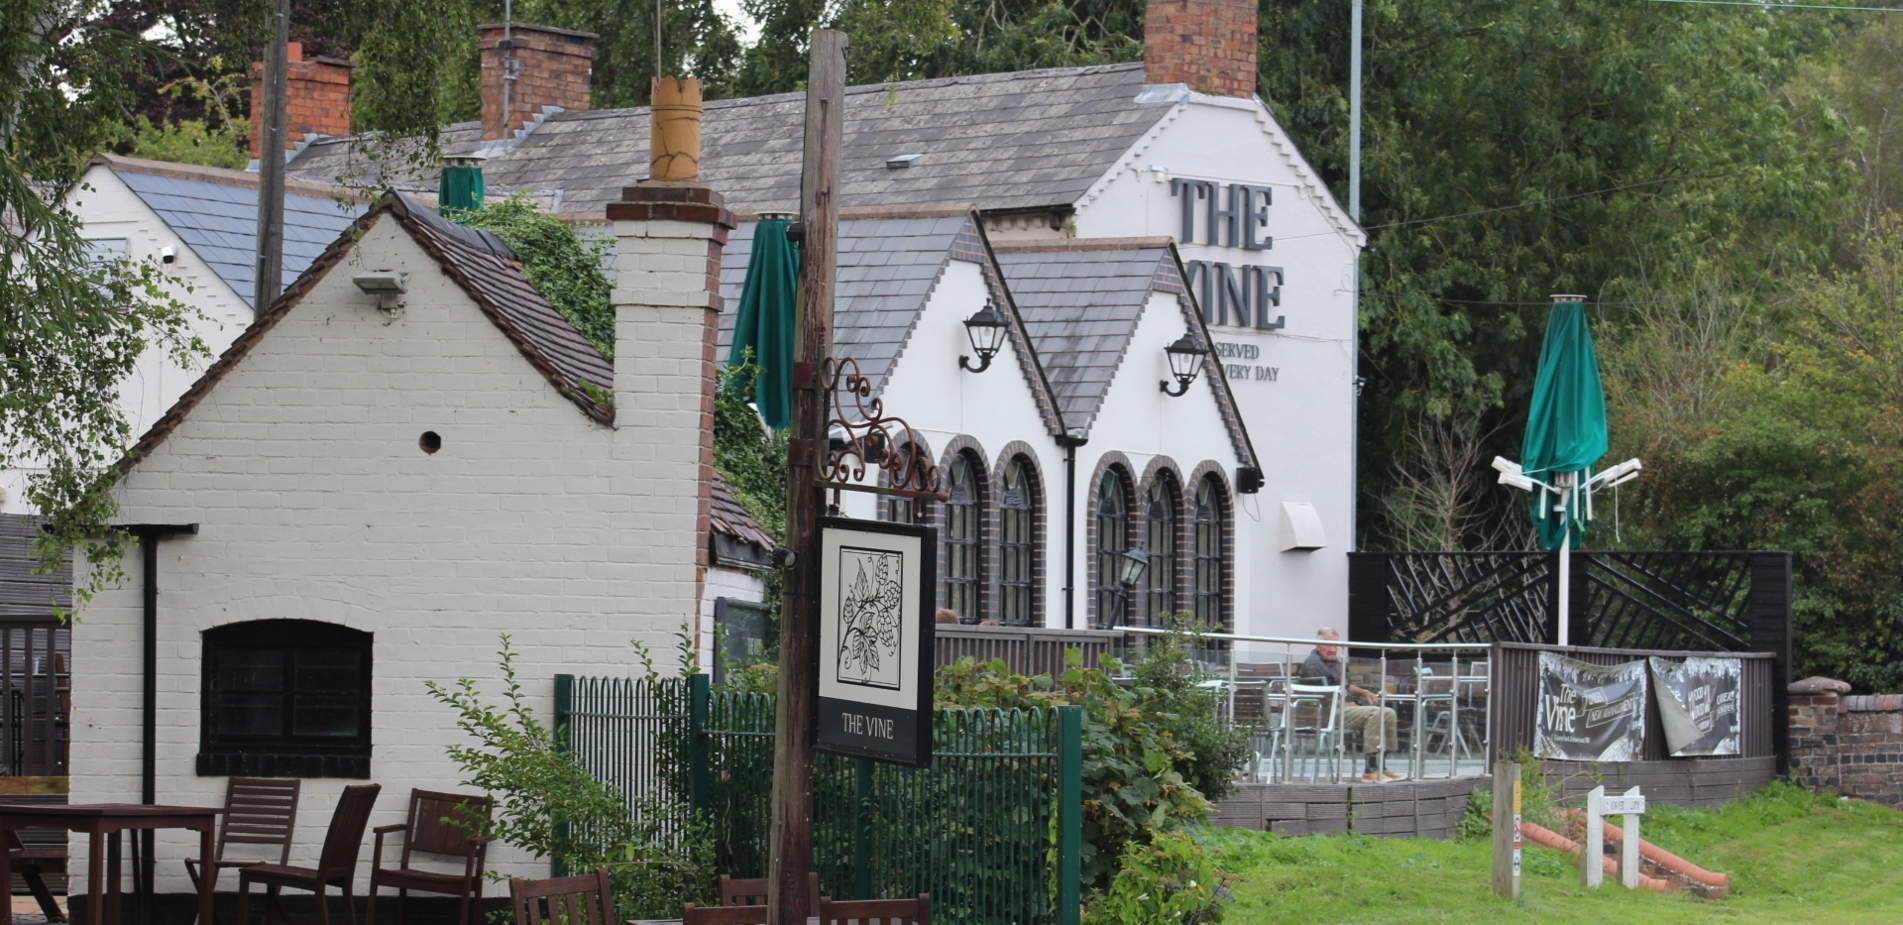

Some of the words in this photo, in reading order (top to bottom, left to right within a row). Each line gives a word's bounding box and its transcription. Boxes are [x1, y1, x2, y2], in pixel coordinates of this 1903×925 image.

[1170, 177, 1273, 251] THE
[1215, 342, 1260, 359] SERVED
[1221, 364, 1252, 379] VERY
[1255, 366, 1280, 381] DAY
[1560, 683, 1577, 704] The
[1545, 694, 1576, 733] Vine
[842, 712, 864, 735] THE
[865, 716, 894, 740] VINE
